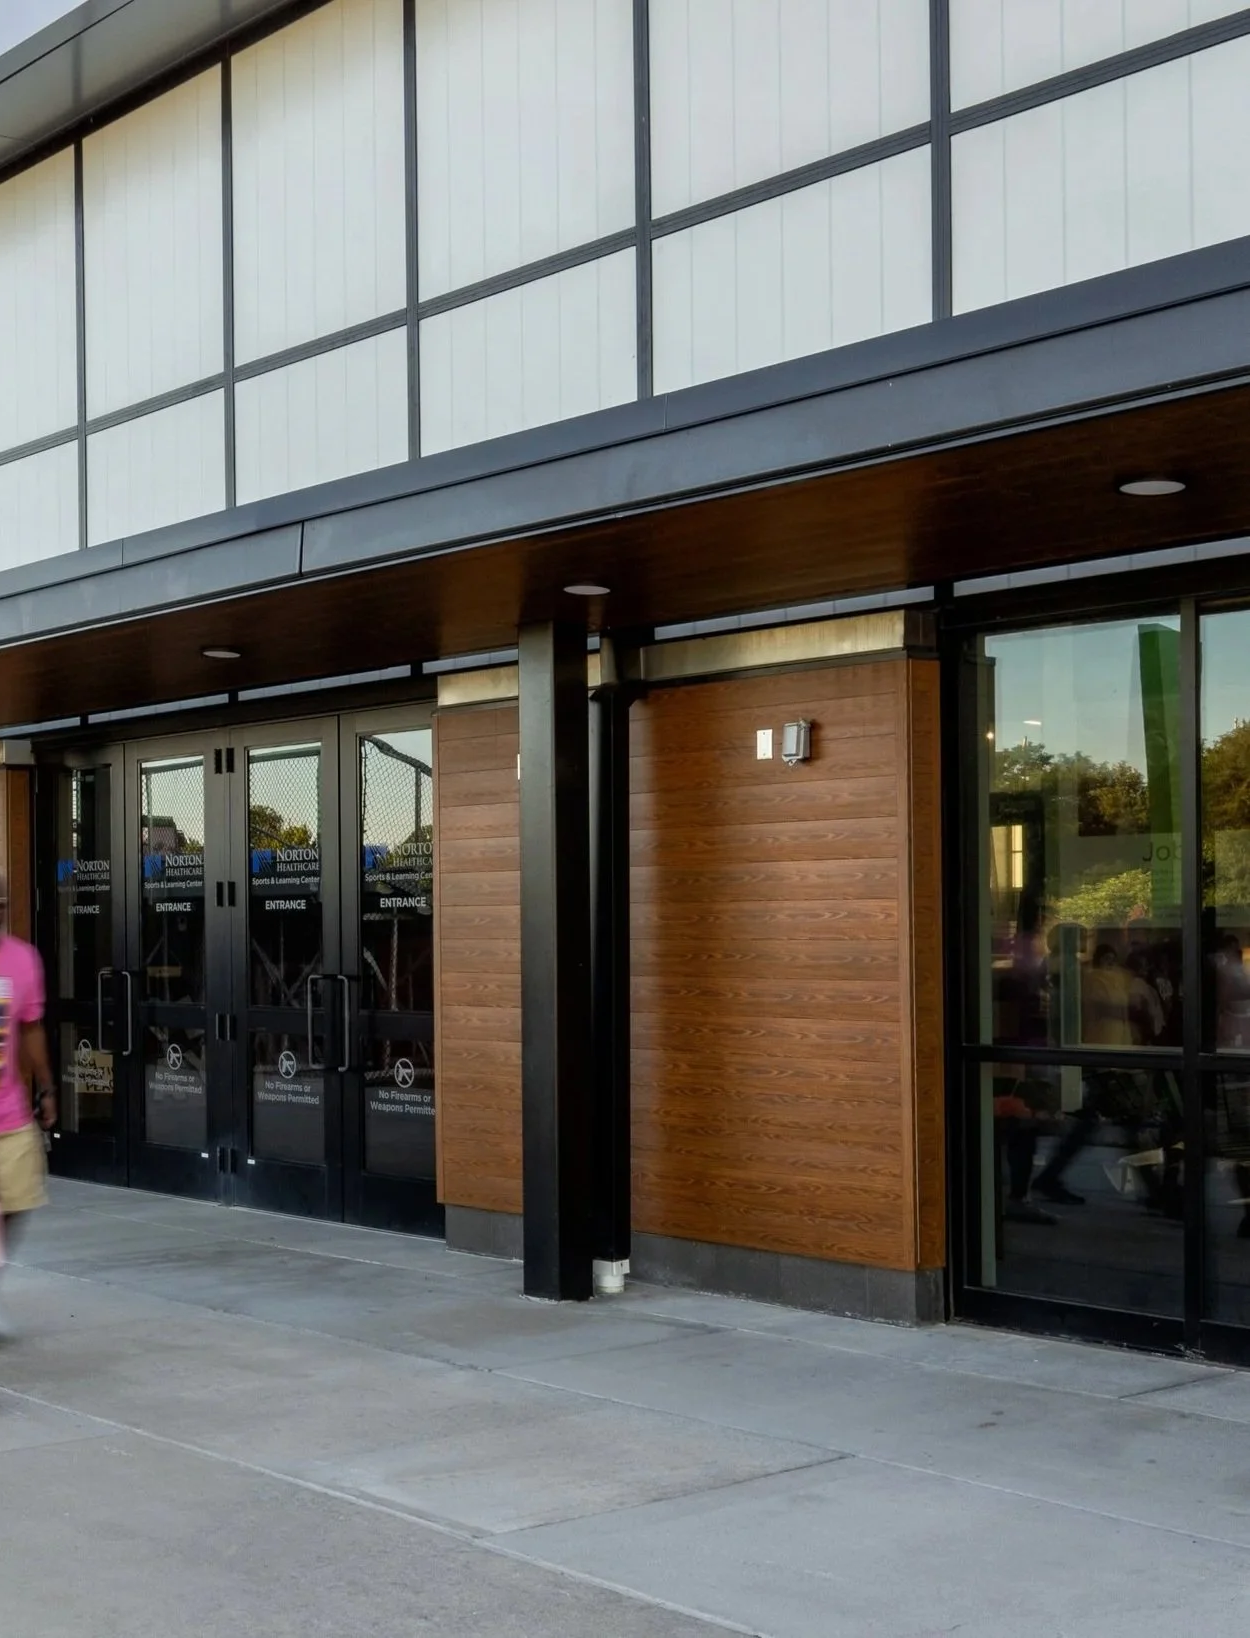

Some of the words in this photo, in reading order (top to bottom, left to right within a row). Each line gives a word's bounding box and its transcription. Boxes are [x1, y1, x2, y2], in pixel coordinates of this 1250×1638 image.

[394, 843, 433, 855] NORTO
[165, 854, 204, 867] NORTON
[276, 849, 319, 862] NORTON
[76, 859, 110, 872] NORTON
[394, 856, 433, 867] HEALTHCA
[166, 867, 203, 876] HEALTHCARE
[277, 862, 320, 872] HEALTHCARE
[77, 872, 110, 881] HEALTHCARE
[252, 877, 270, 885] Sports
[276, 876, 300, 885] Learning
[301, 875, 320, 883] Center
[365, 873, 385, 882] Sports
[392, 872, 419, 881] Learning
[165, 881, 185, 889] Learning
[156, 902, 191, 912] ENTRANCE
[265, 900, 306, 910] ENTRANCE
[380, 897, 426, 908] ENTRANCE
[68, 905, 100, 914] ENTRANCE
[155, 1072, 163, 1080] No
[164, 1073, 187, 1082] Firearms
[265, 1081, 274, 1089] No
[276, 1082, 303, 1092] Firearms
[258, 1092, 287, 1102] Weapons
[288, 1094, 320, 1105] Permitted
[379, 1090, 389, 1099] No
[390, 1091, 422, 1102] Firearms
[370, 1101, 403, 1113] Weapons
[405, 1104, 435, 1115] Permitte
